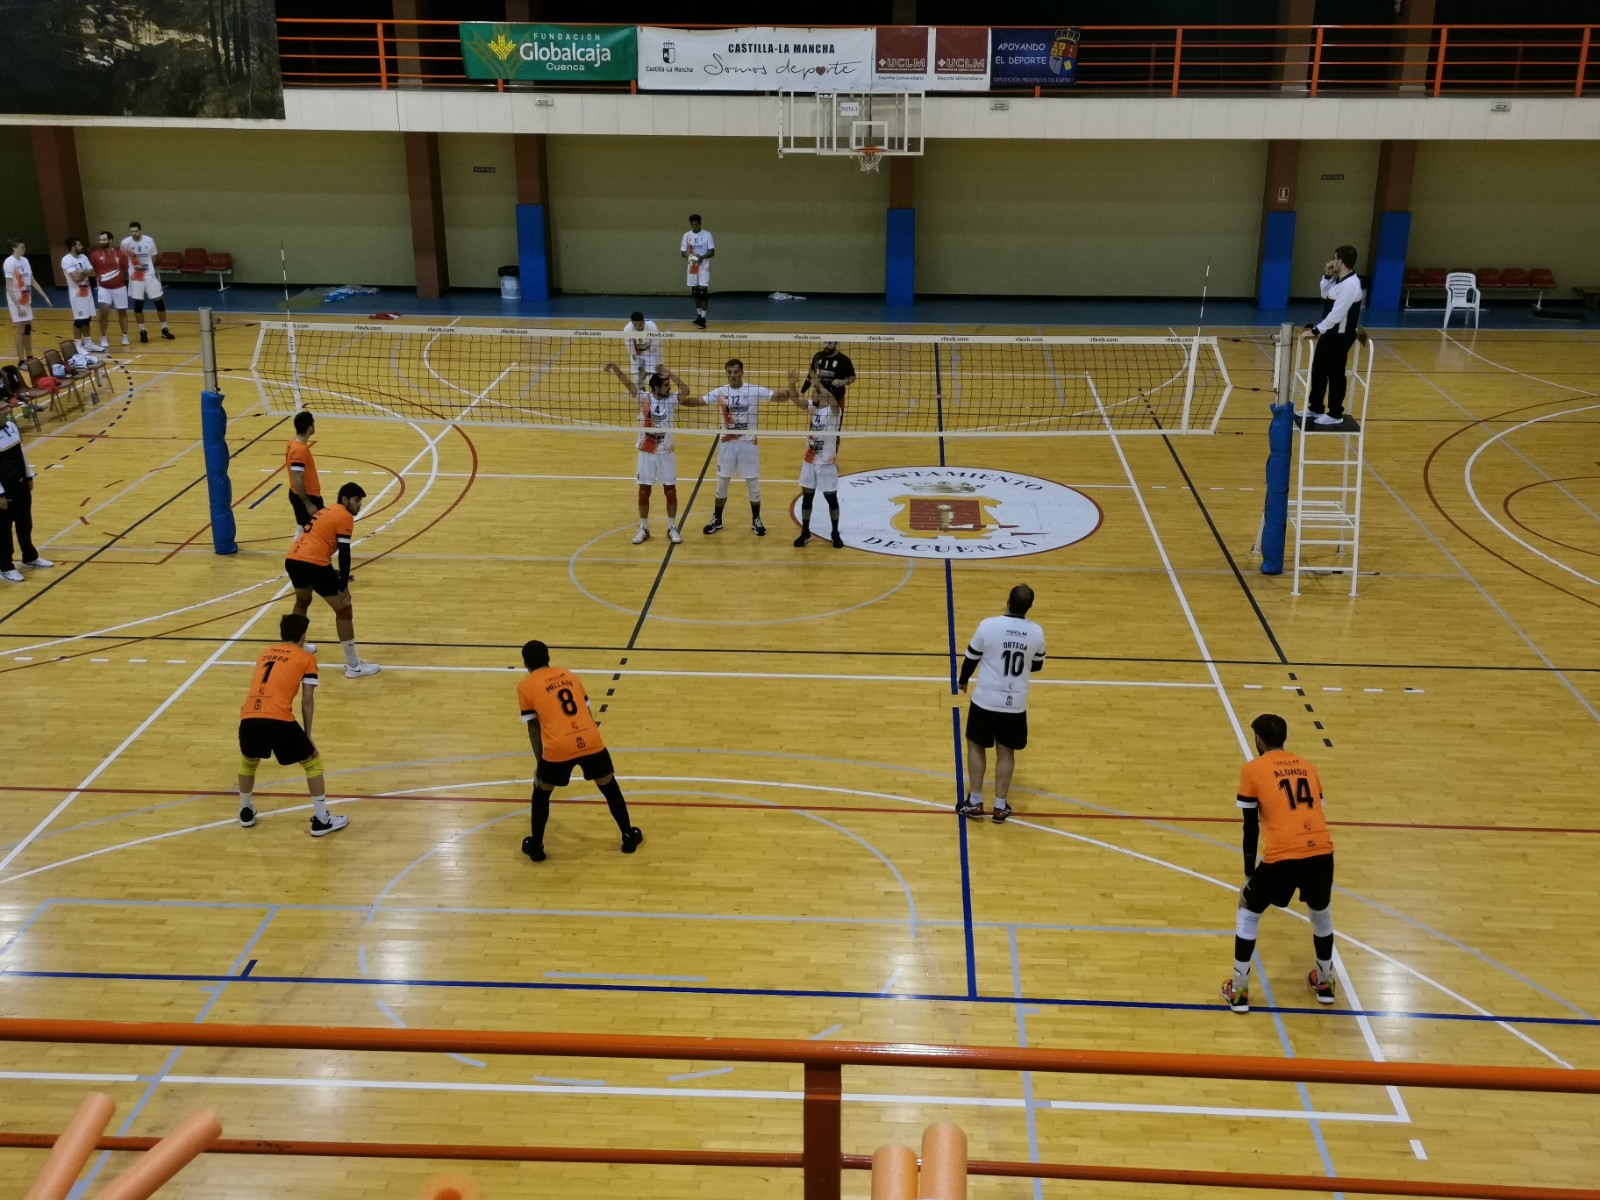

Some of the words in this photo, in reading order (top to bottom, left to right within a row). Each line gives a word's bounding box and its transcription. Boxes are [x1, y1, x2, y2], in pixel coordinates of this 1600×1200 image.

[534, 32, 600, 41] FUNDACIÓN
[728, 43, 790, 54] CASTILLA-LA
[794, 44, 835, 54] MANCHA
[998, 43, 1046, 51] APOYANDO
[519, 42, 612, 68] Globalcaja
[887, 58, 926, 68] UCLM
[946, 58, 985, 68] UCLM
[995, 56, 1005, 64] EL
[1008, 56, 1047, 65] DEPORTE
[546, 62, 585, 71] Cuenca
[704, 53, 767, 75] Somos
[776, 59, 863, 80] deprte
[732, 396, 740, 406] 12
[849, 470, 1044, 492] AYUNTAMIENTO
[862, 536, 904, 549] DE
[910, 538, 1038, 554] CUENCA
[1003, 642, 1028, 651] ORTEGA
[1001, 650, 1025, 677] 10
[262, 661, 276, 684] 1
[557, 688, 577, 717] 8
[1273, 768, 1307, 778] ALONSO
[1278, 777, 1314, 810] 14
